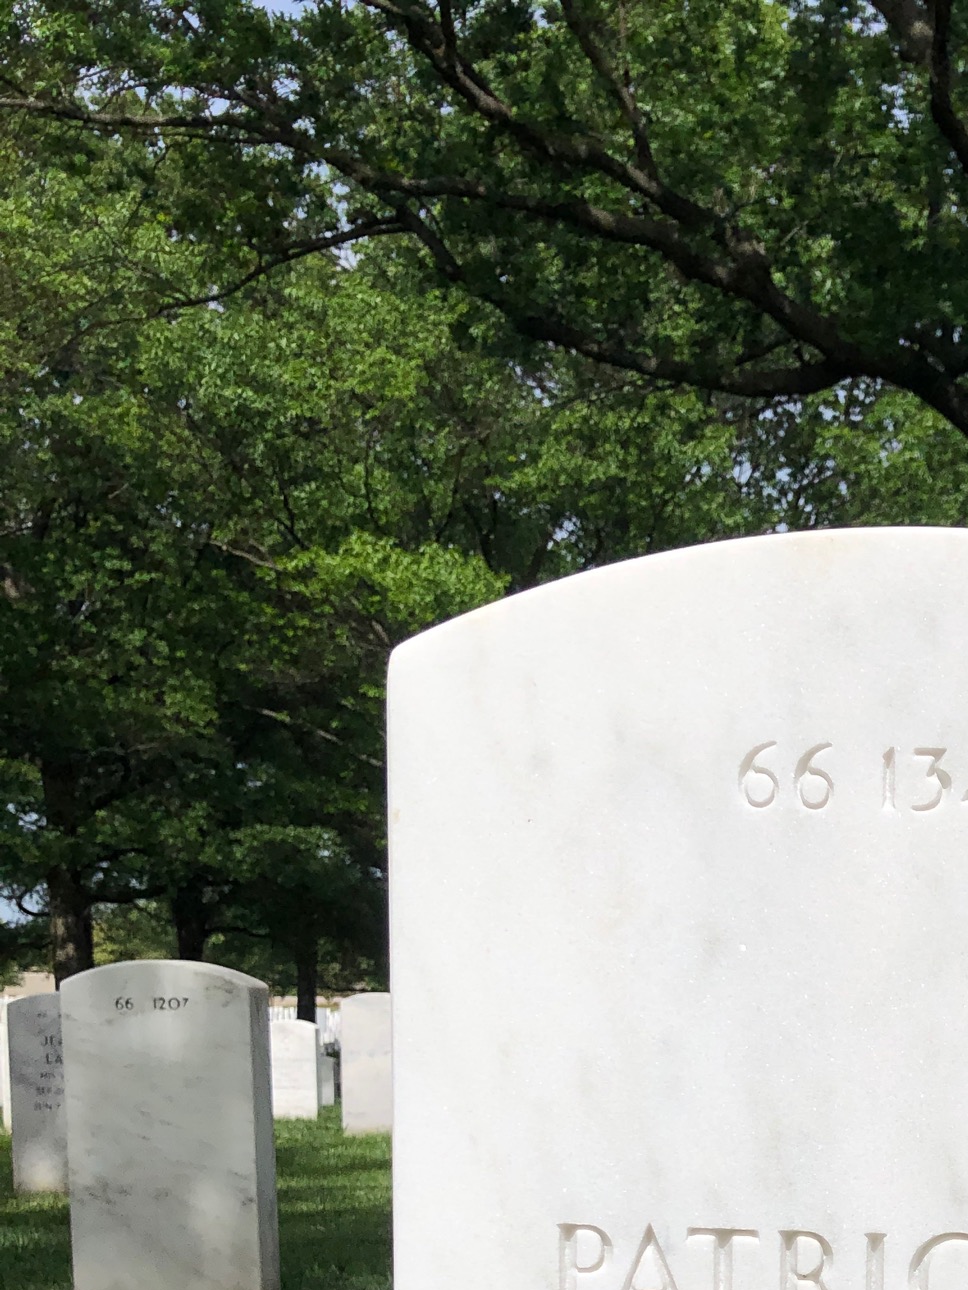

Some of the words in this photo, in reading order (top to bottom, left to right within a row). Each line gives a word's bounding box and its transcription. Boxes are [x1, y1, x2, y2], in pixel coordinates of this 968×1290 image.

[738, 740, 834, 810] 66
[115, 996, 134, 1010] 66
[152, 996, 189, 1010] 1207
